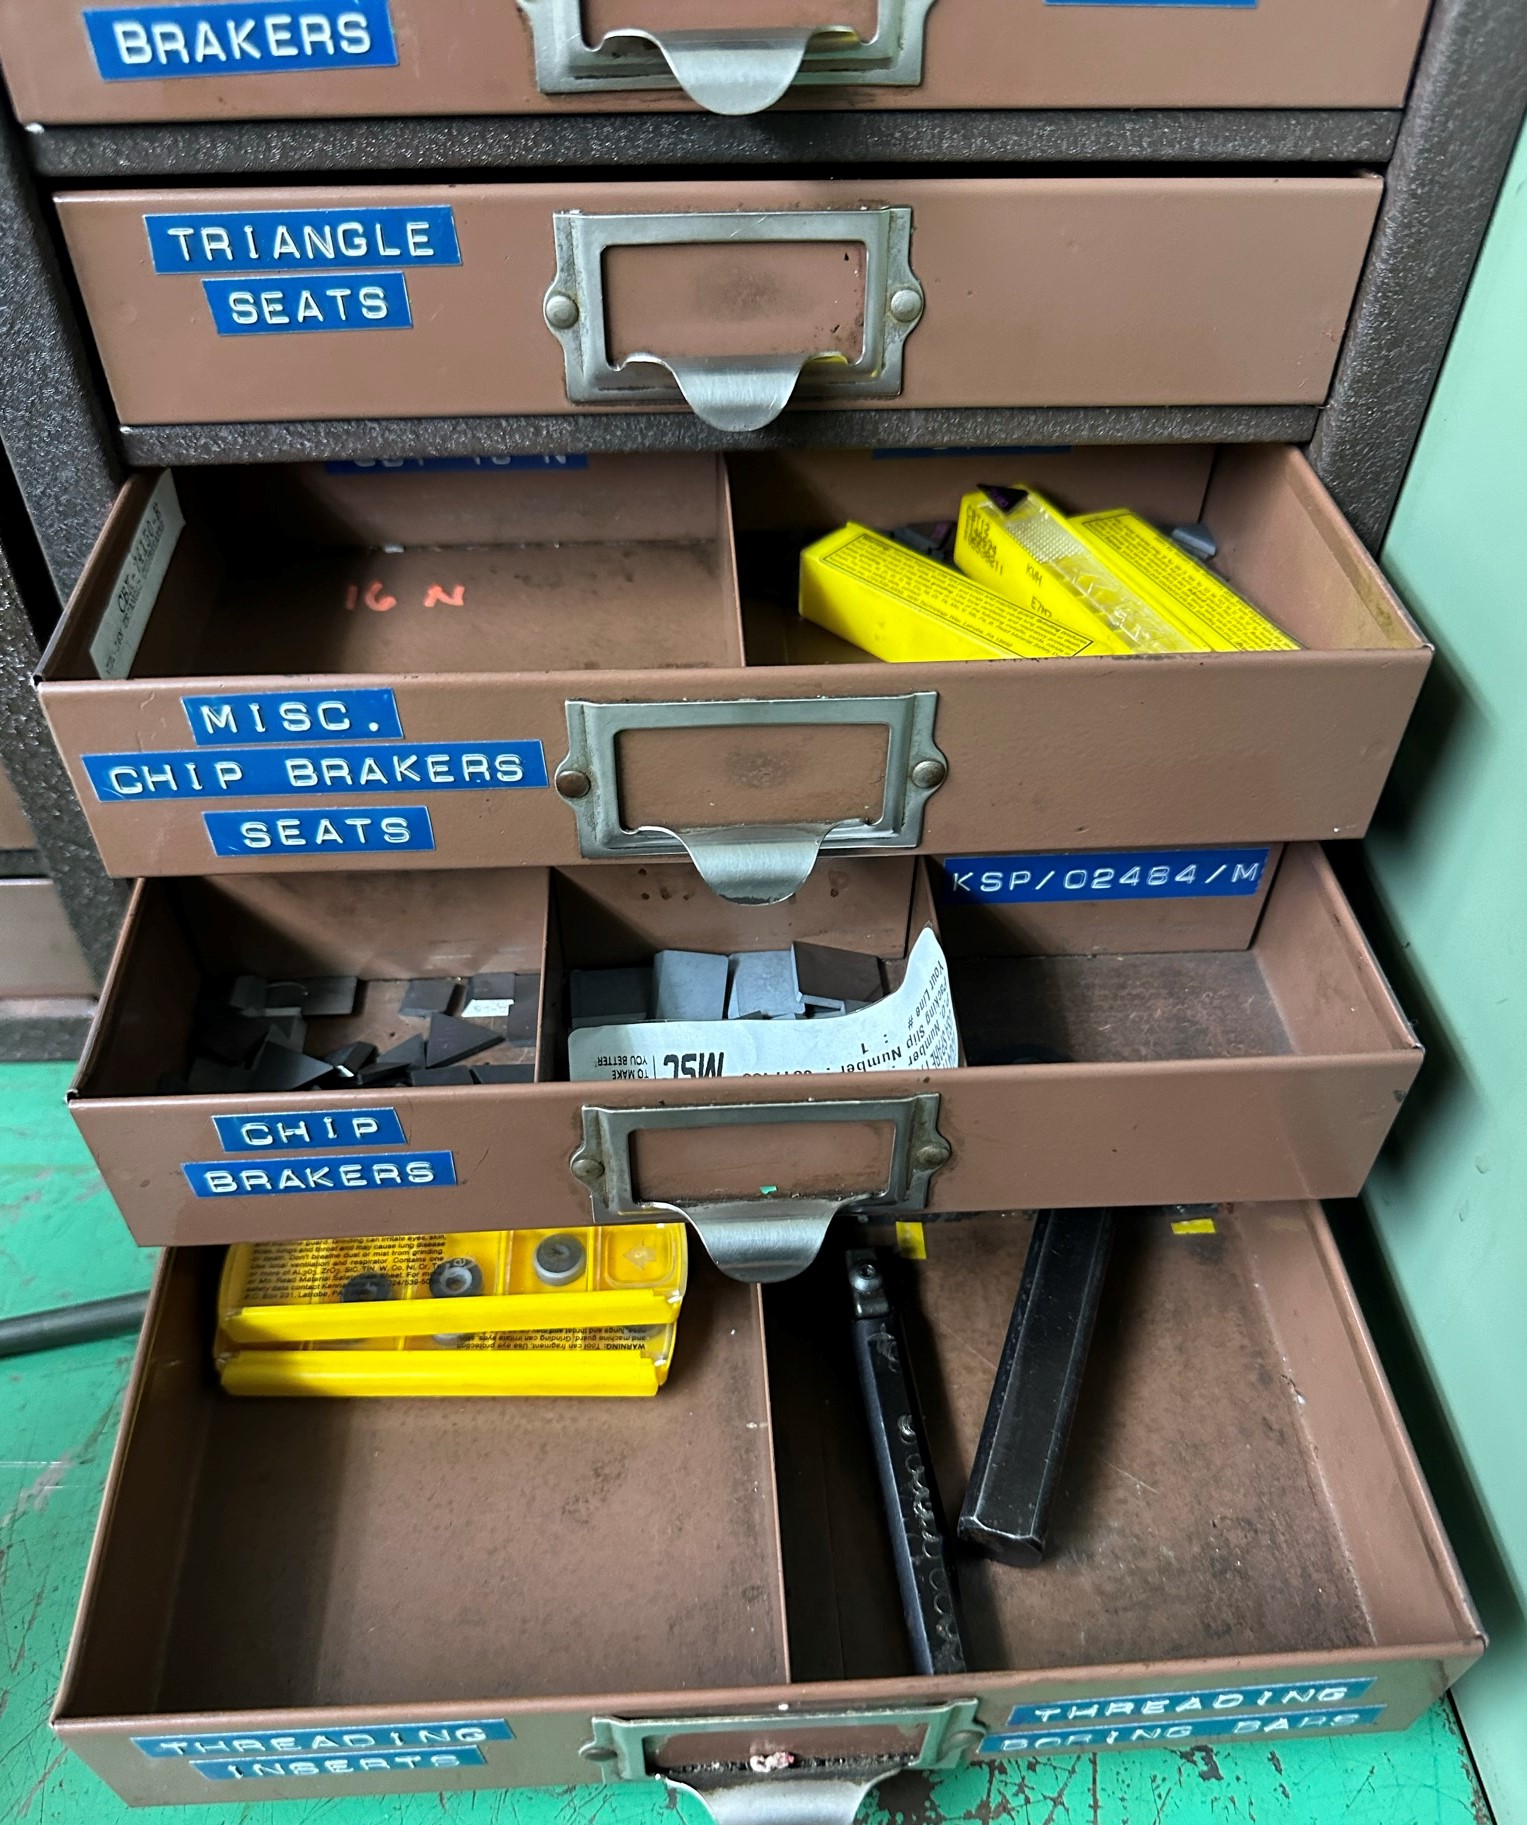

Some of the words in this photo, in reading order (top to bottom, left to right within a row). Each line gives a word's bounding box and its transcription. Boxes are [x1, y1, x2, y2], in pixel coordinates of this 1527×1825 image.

[113, 11, 373, 66] BRAKERS
[167, 221, 436, 264] TRIANGLE
[229, 285, 390, 326] SEATS
[345, 581, 397, 613] 16
[423, 583, 467, 609] N
[201, 701, 381, 735] MISC.
[110, 761, 243, 796] CHIP
[286, 754, 526, 788] BRAKERS
[241, 816, 412, 849] SEATS
[929, 960, 944, 991] Your
[915, 988, 931, 1018] Line
[906, 1024, 926, 1049] Slip
[908, 1019, 940, 1066] Number
[612, 1070, 635, 1079] MAKE
[630, 1055, 648, 1065] YOU
[638, 1069, 649, 1078] TO
[663, 1052, 724, 1078] MSC
[841, 1046, 902, 1073] Number
[242, 1117, 382, 1147] CHIP
[204, 1160, 437, 1194] BRAKERS
[1035, 1687, 1347, 1721] THREADING
[161, 1727, 488, 1755] THREADING
[229, 1754, 460, 1778] INSERTS
